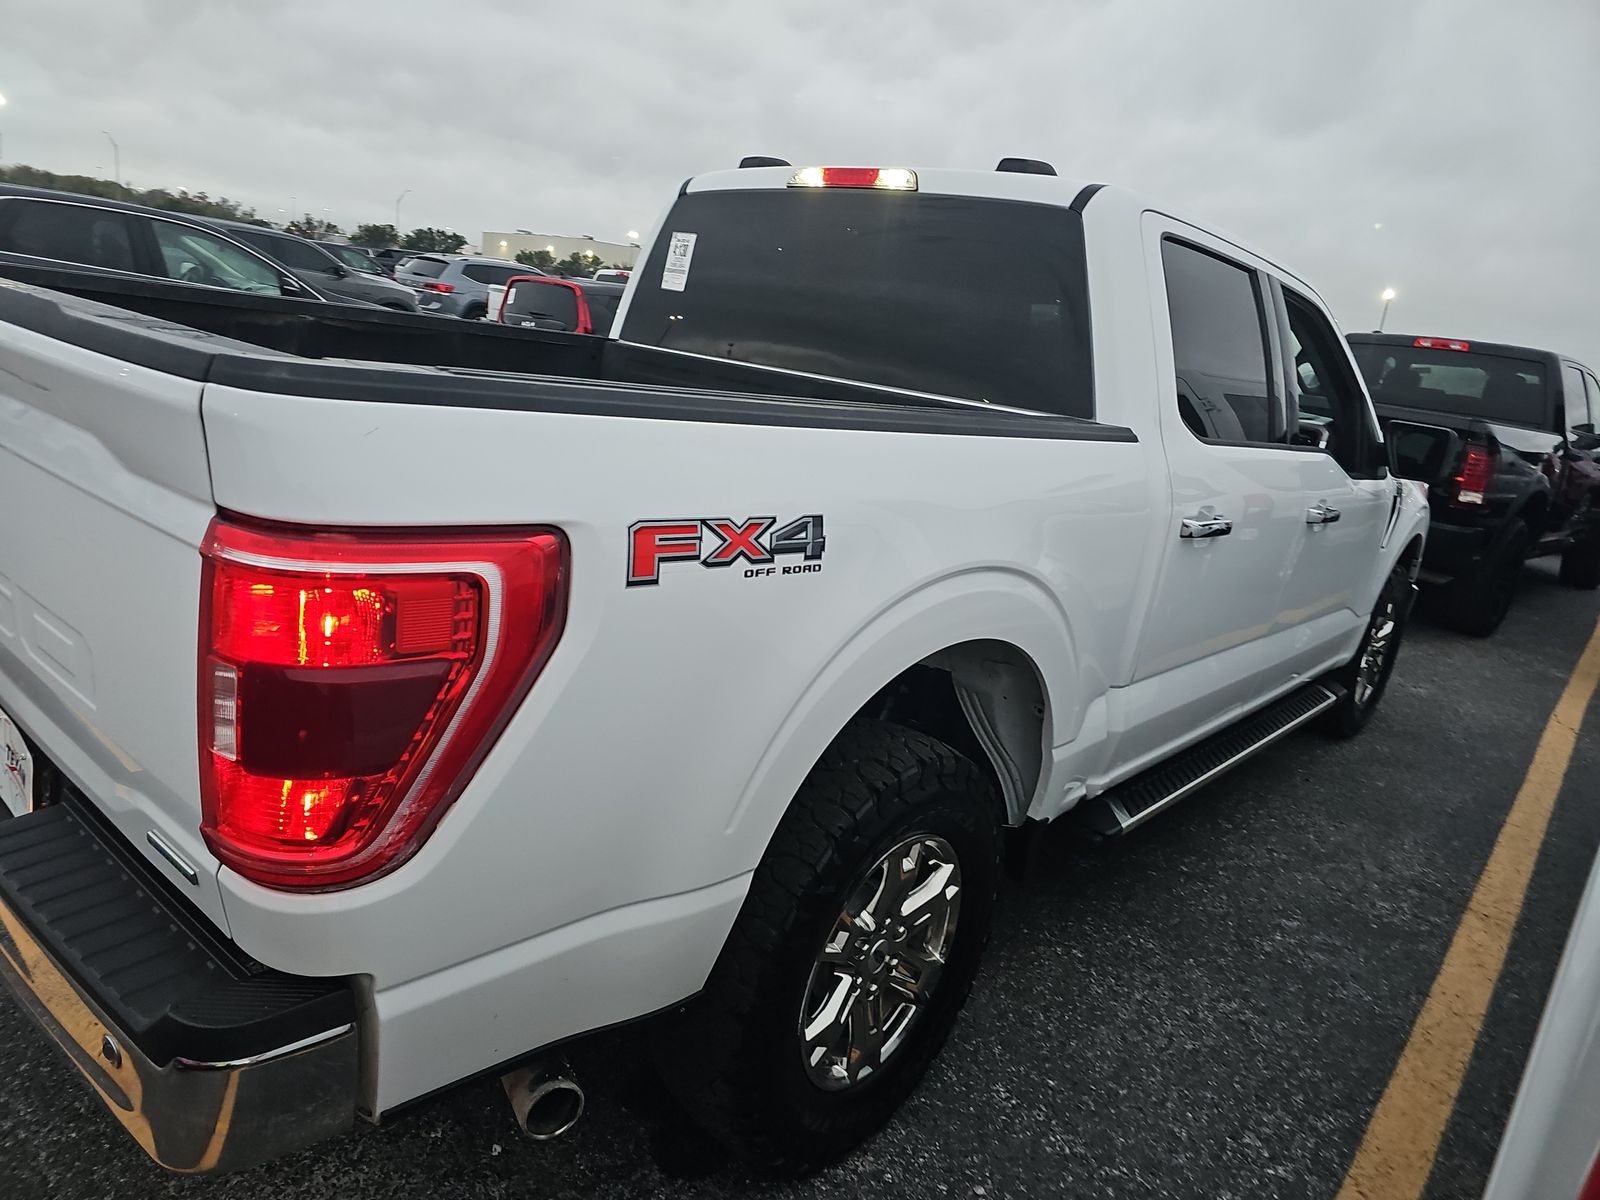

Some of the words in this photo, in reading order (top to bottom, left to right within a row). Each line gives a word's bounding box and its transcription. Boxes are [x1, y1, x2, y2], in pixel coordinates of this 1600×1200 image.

[626, 514, 826, 588] FX4
[743, 567, 777, 579] OFF
[781, 563, 822, 576] ROAD
